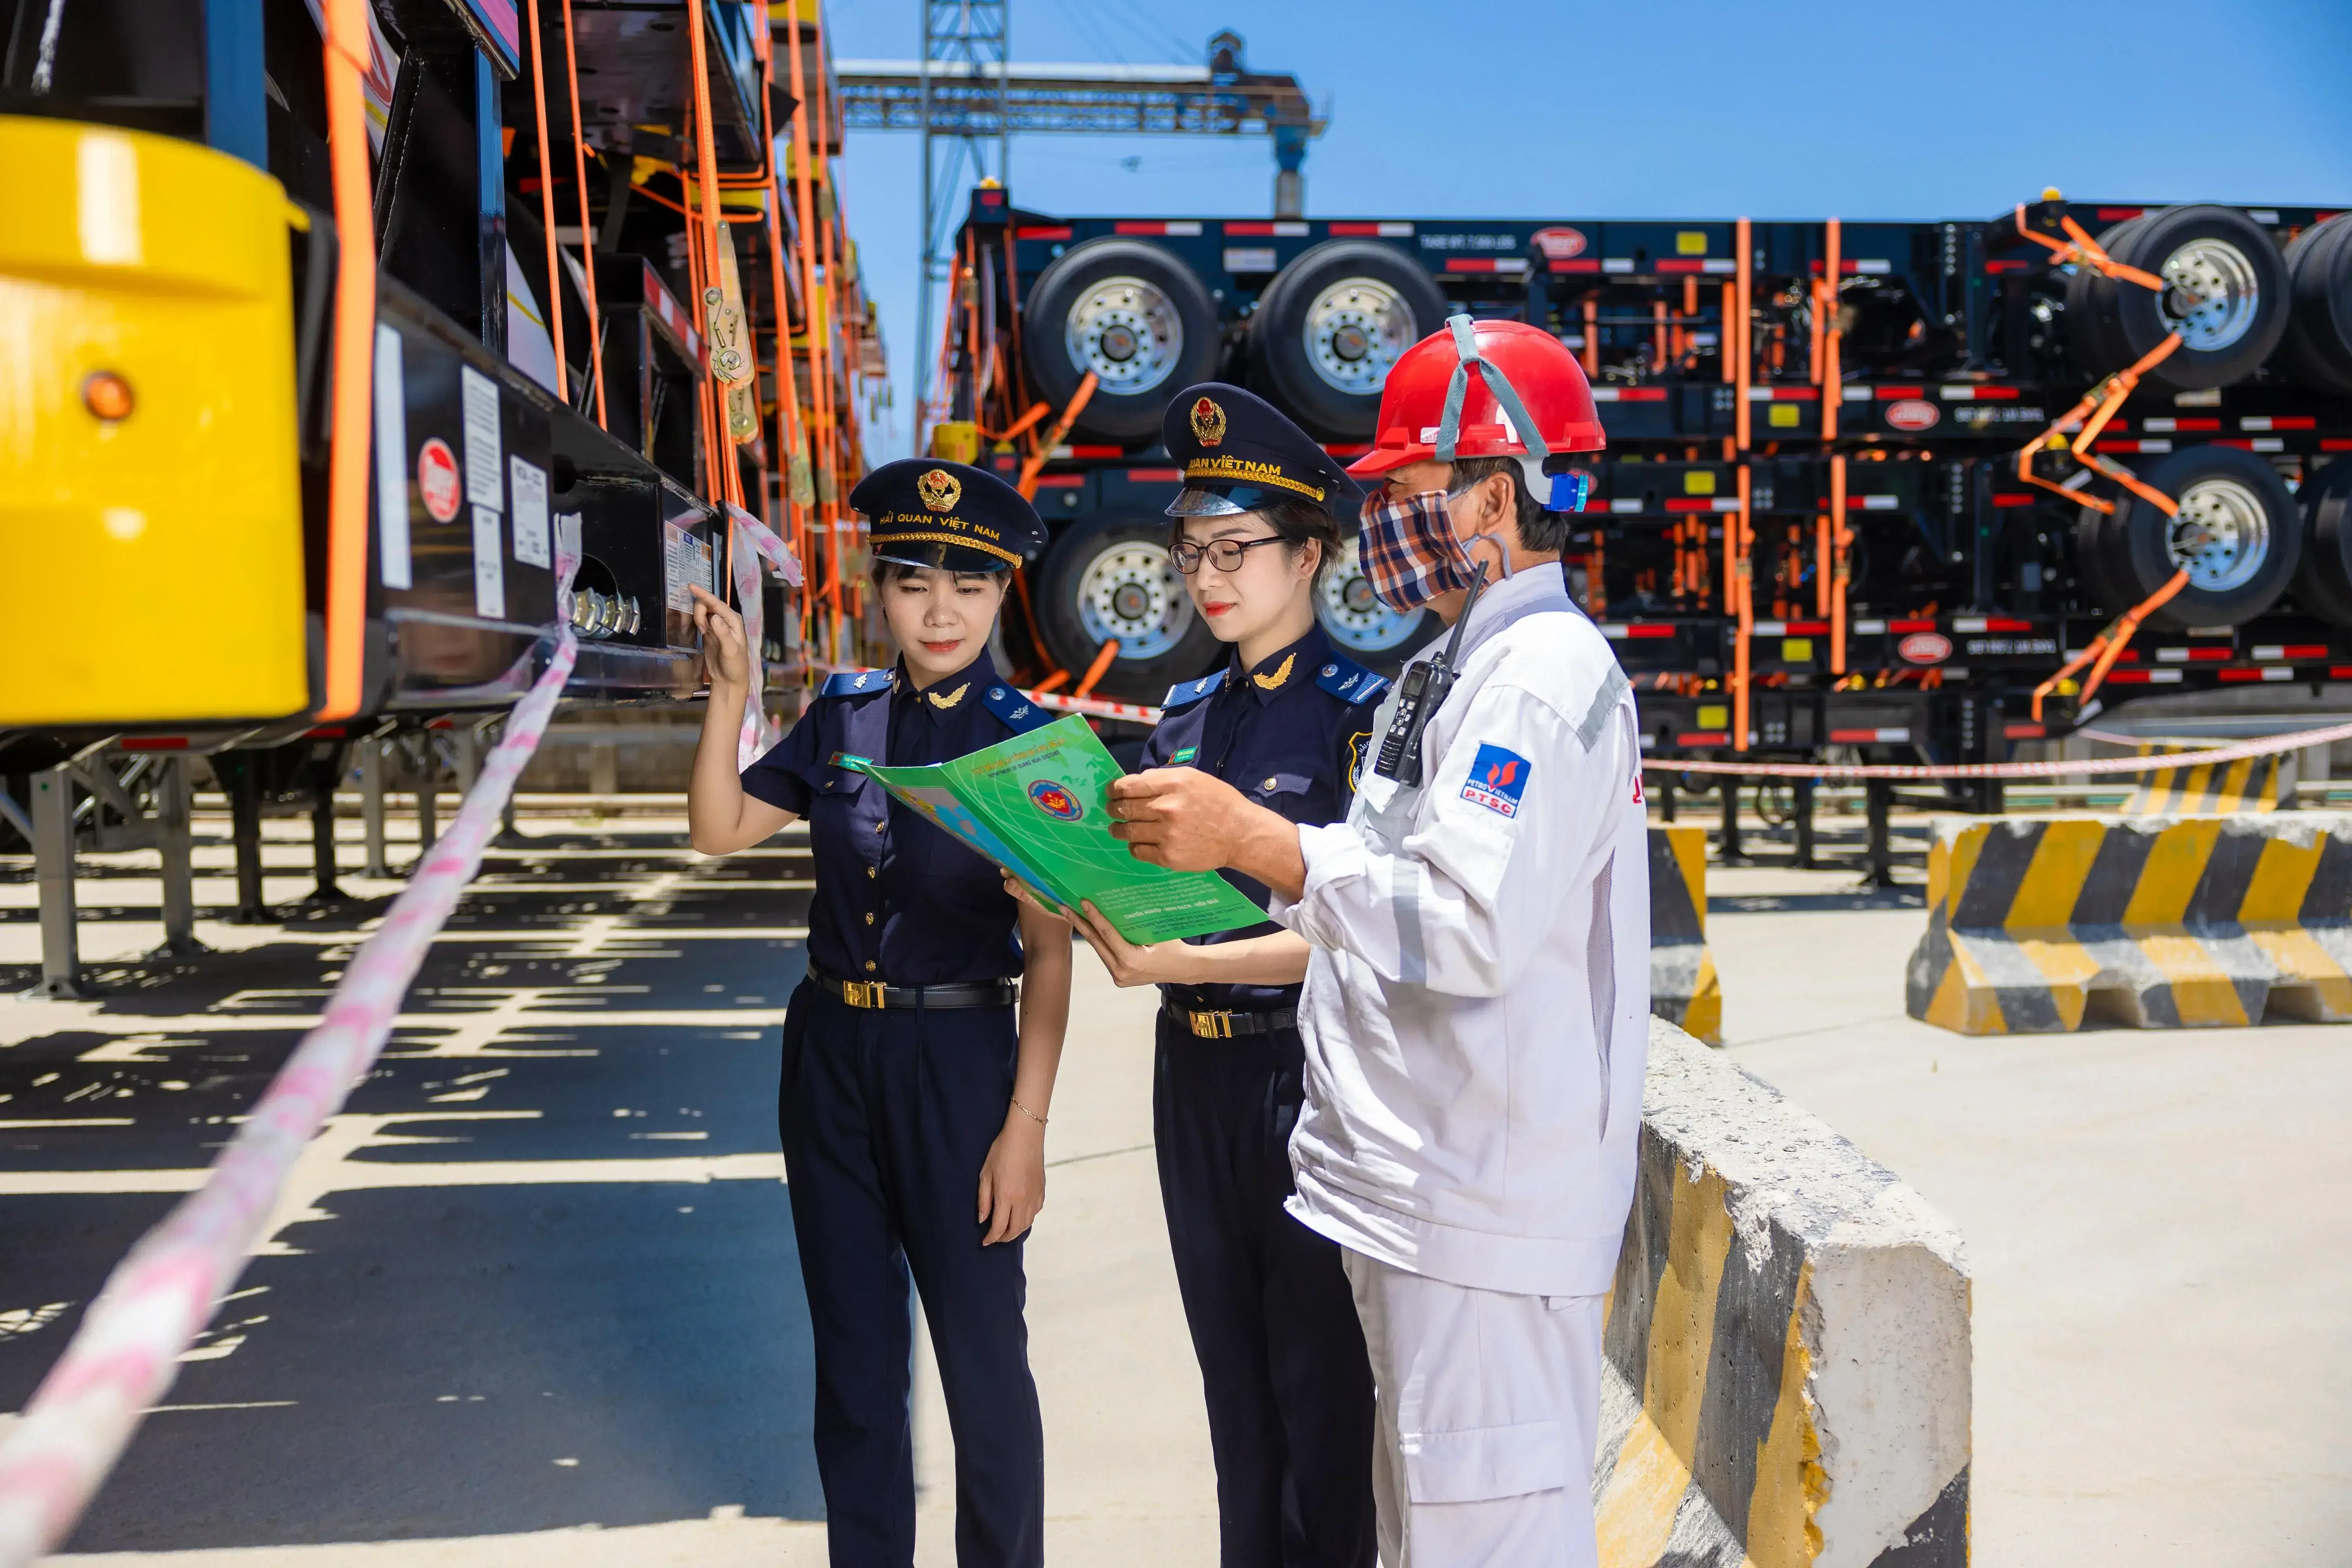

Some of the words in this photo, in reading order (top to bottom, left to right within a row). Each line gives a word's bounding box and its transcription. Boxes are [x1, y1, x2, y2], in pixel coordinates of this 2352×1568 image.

[1245, 461, 1281, 475] NAM
[880, 510, 894, 525] HẢI
[897, 514, 933, 524] QUAN
[939, 516, 969, 530] VIỆT
[974, 524, 1000, 541] NAM
[987, 767, 1011, 779] DEPARTMENT
